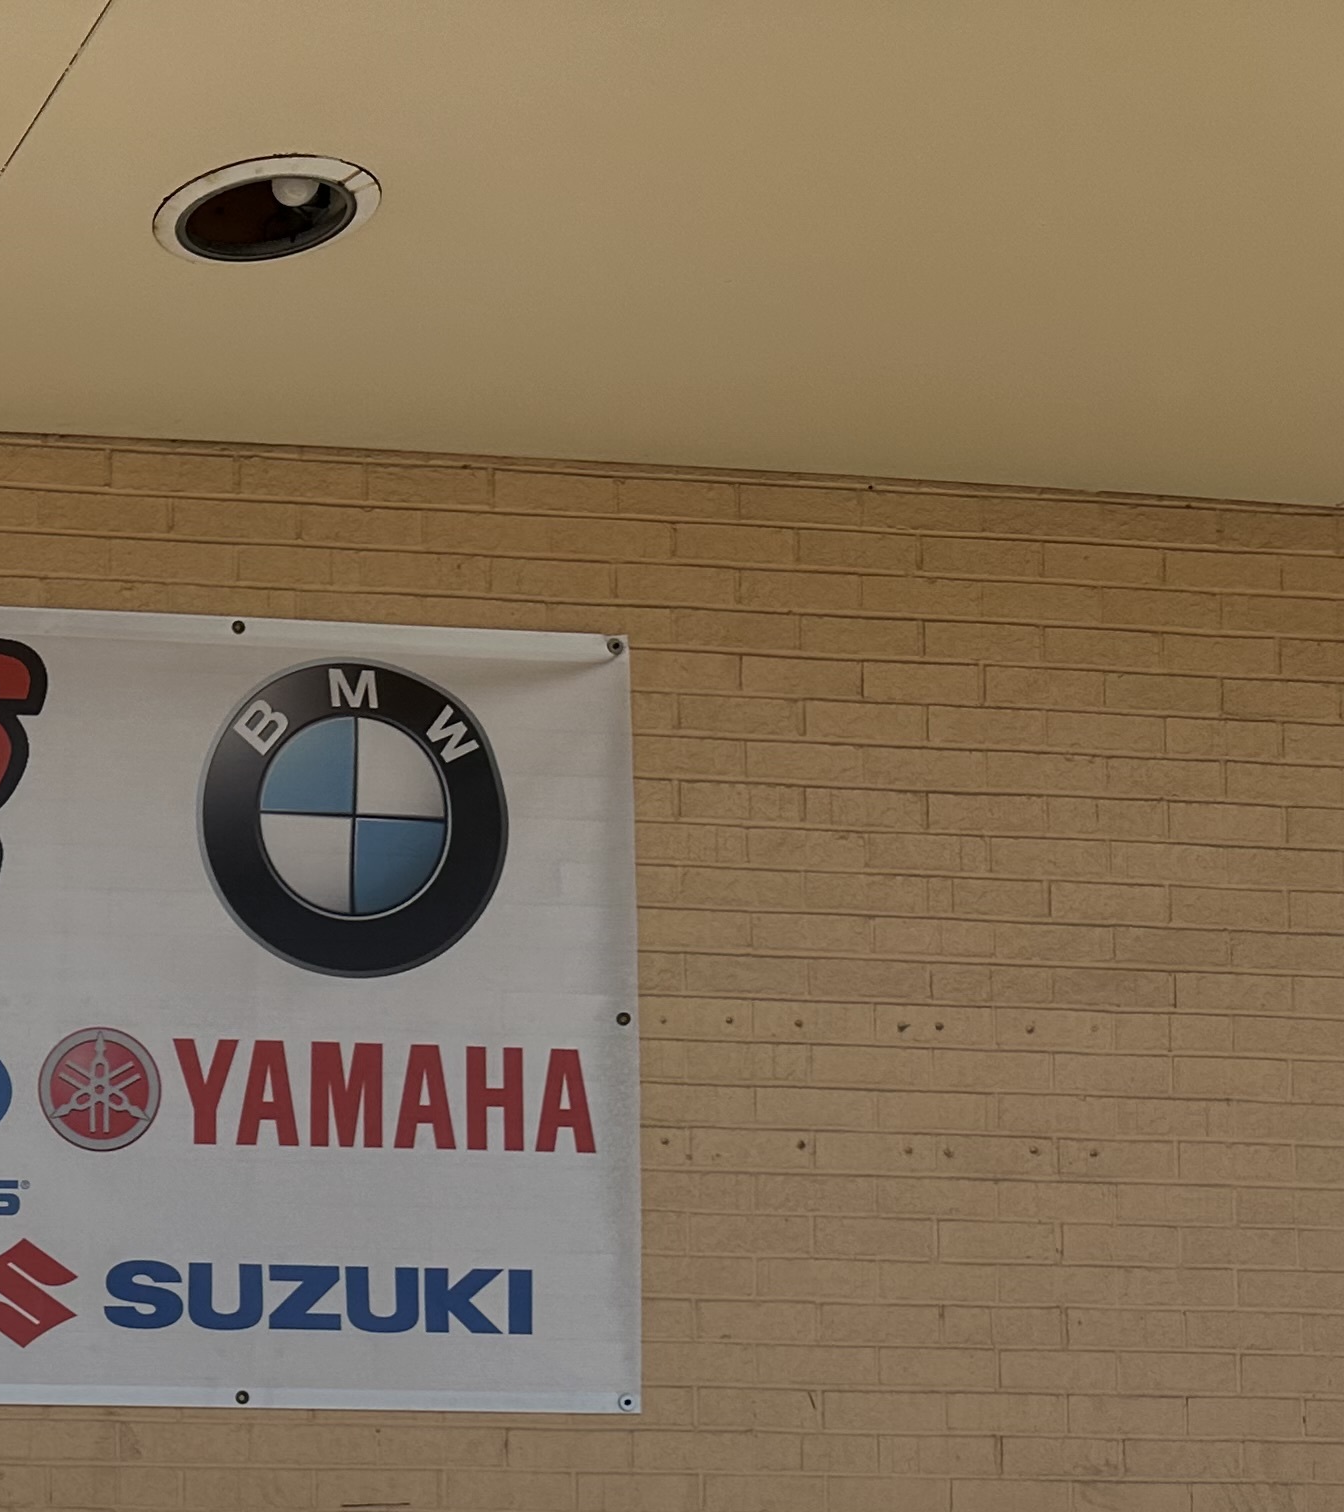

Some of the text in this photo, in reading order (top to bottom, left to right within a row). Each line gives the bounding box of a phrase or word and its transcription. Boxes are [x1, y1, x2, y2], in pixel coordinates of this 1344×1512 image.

[233, 668, 480, 766] BMW
[171, 1038, 598, 1154] YAMAHA
[103, 1259, 533, 1336] SUZUKI
